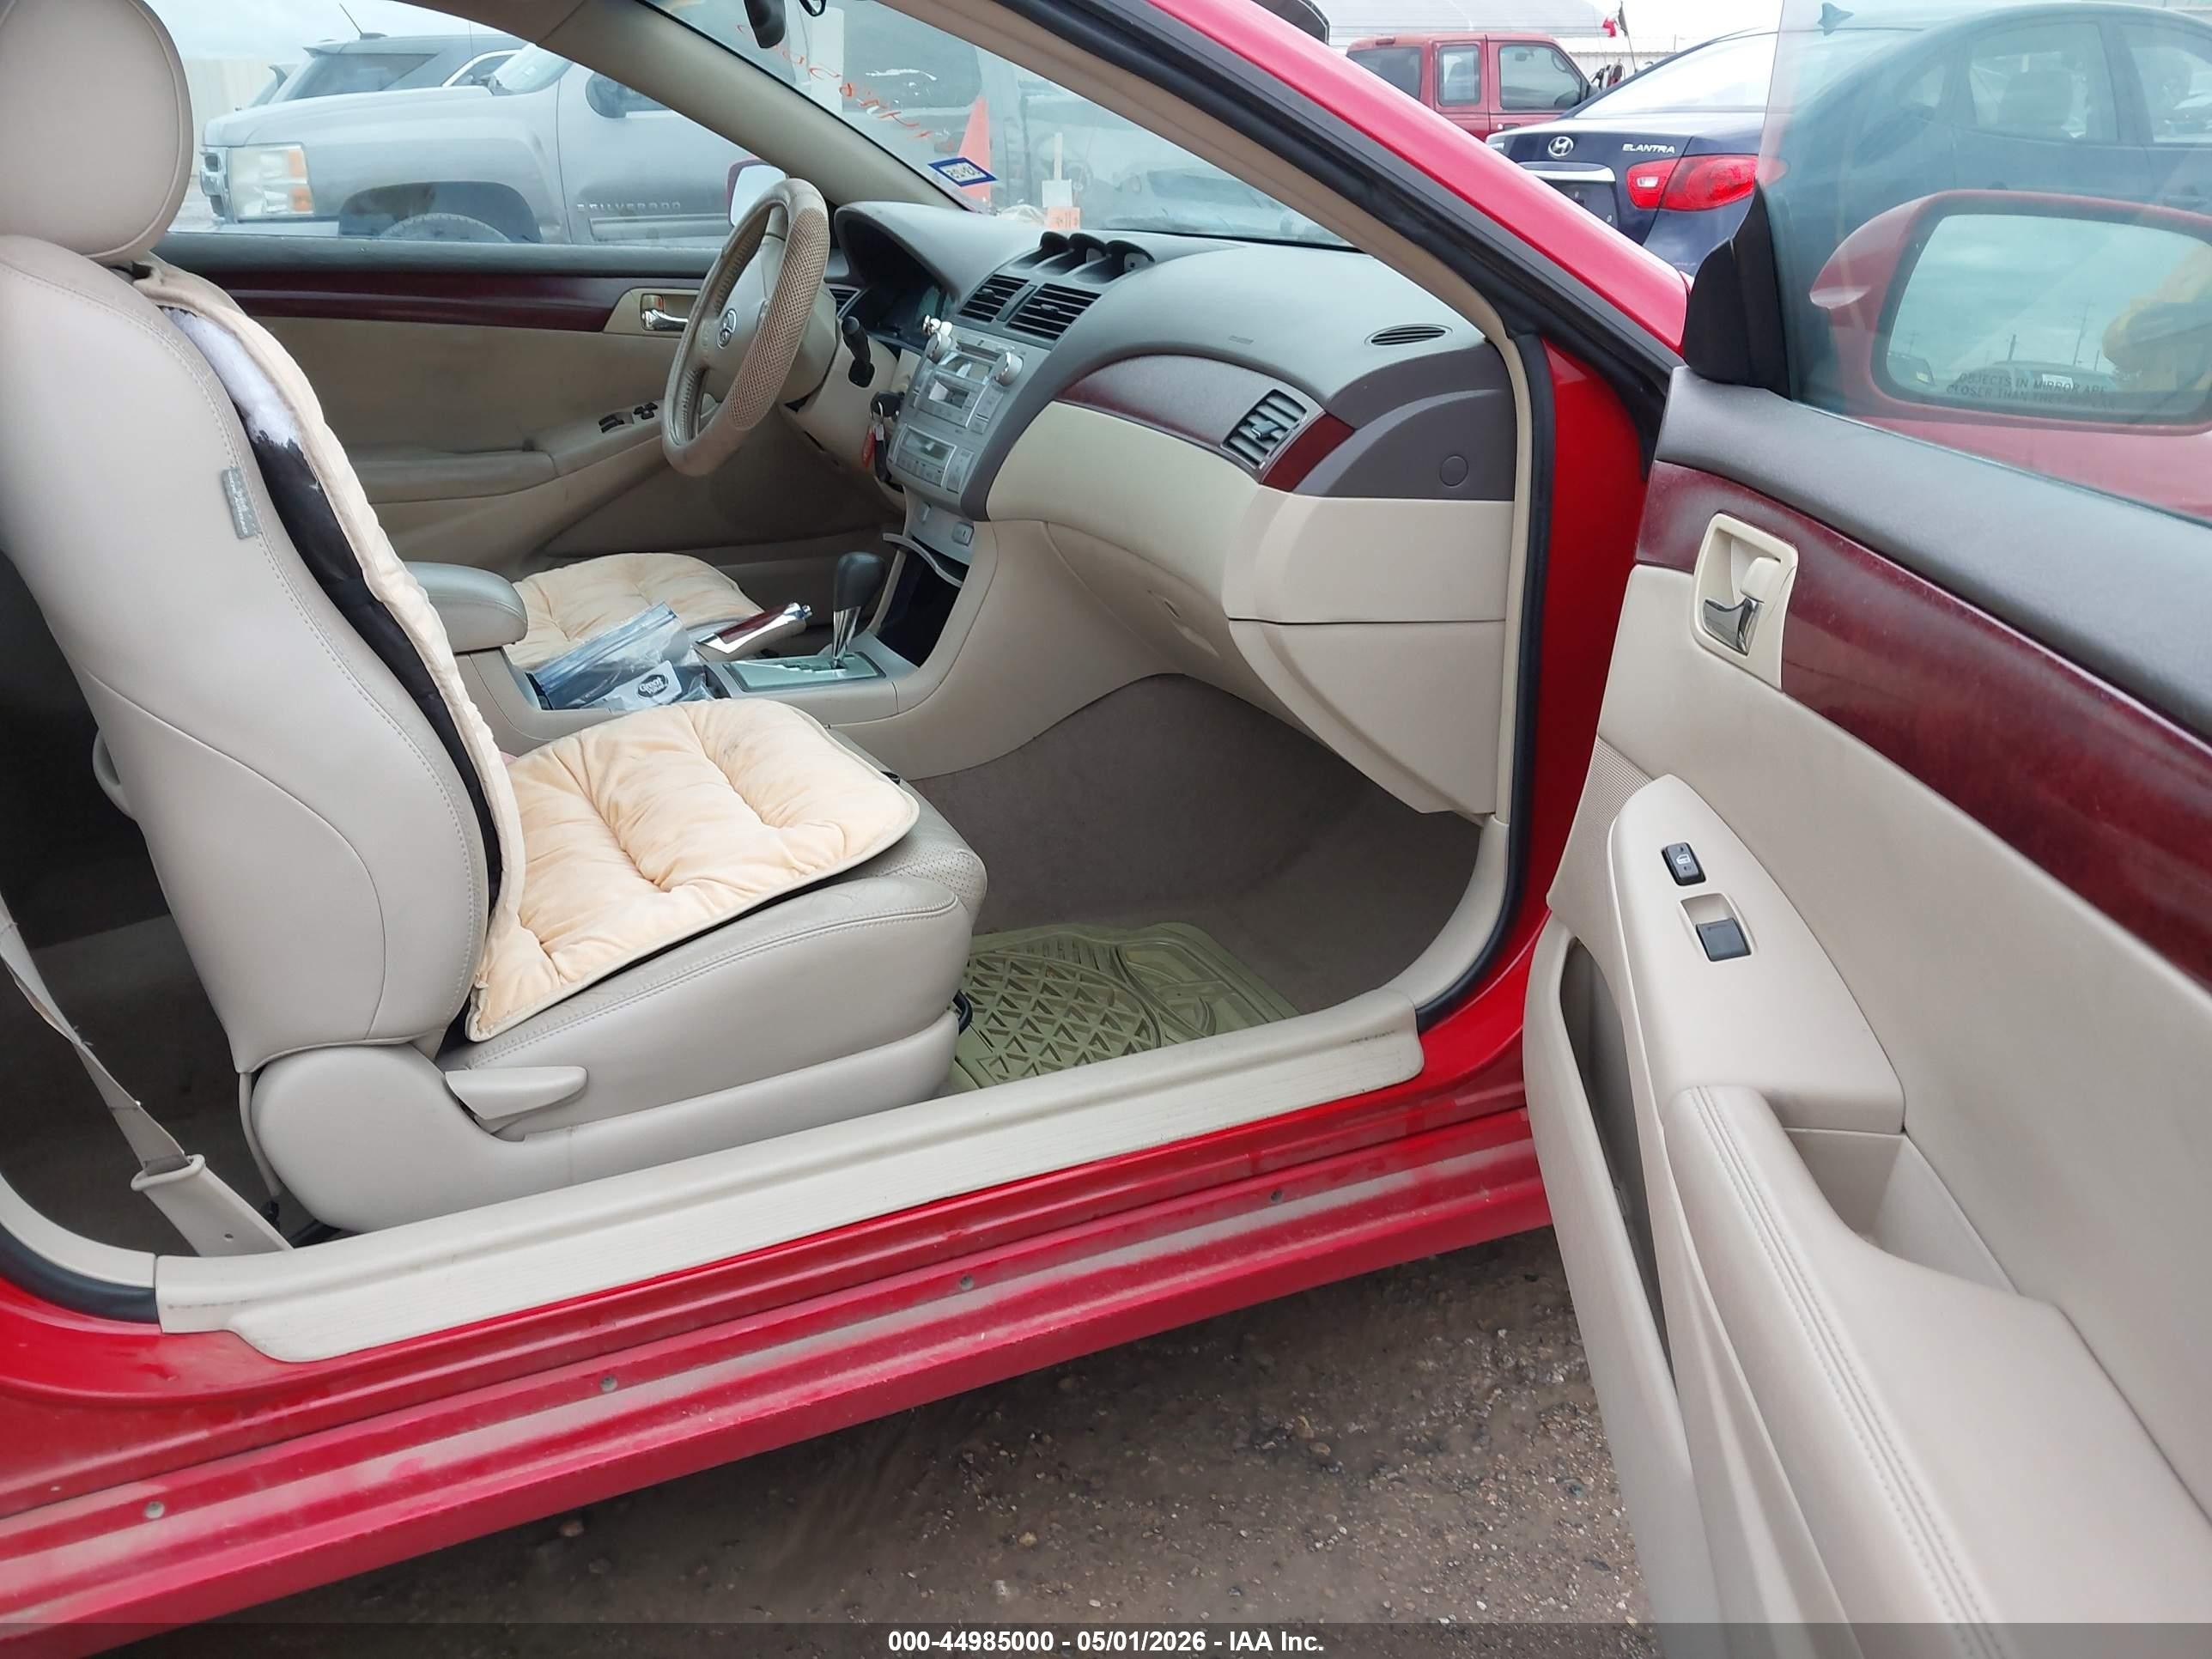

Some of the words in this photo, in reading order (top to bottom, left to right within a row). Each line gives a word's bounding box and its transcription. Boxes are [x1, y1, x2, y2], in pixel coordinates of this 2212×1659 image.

[1622, 143, 1674, 153] ELANTRA
[1959, 373, 2013, 386] OBJECTS
[2016, 377, 2028, 388] IN
[2033, 379, 2081, 392] MIRROR
[1947, 384, 1992, 399] CLOSER
[639, 677, 663, 692] Great
